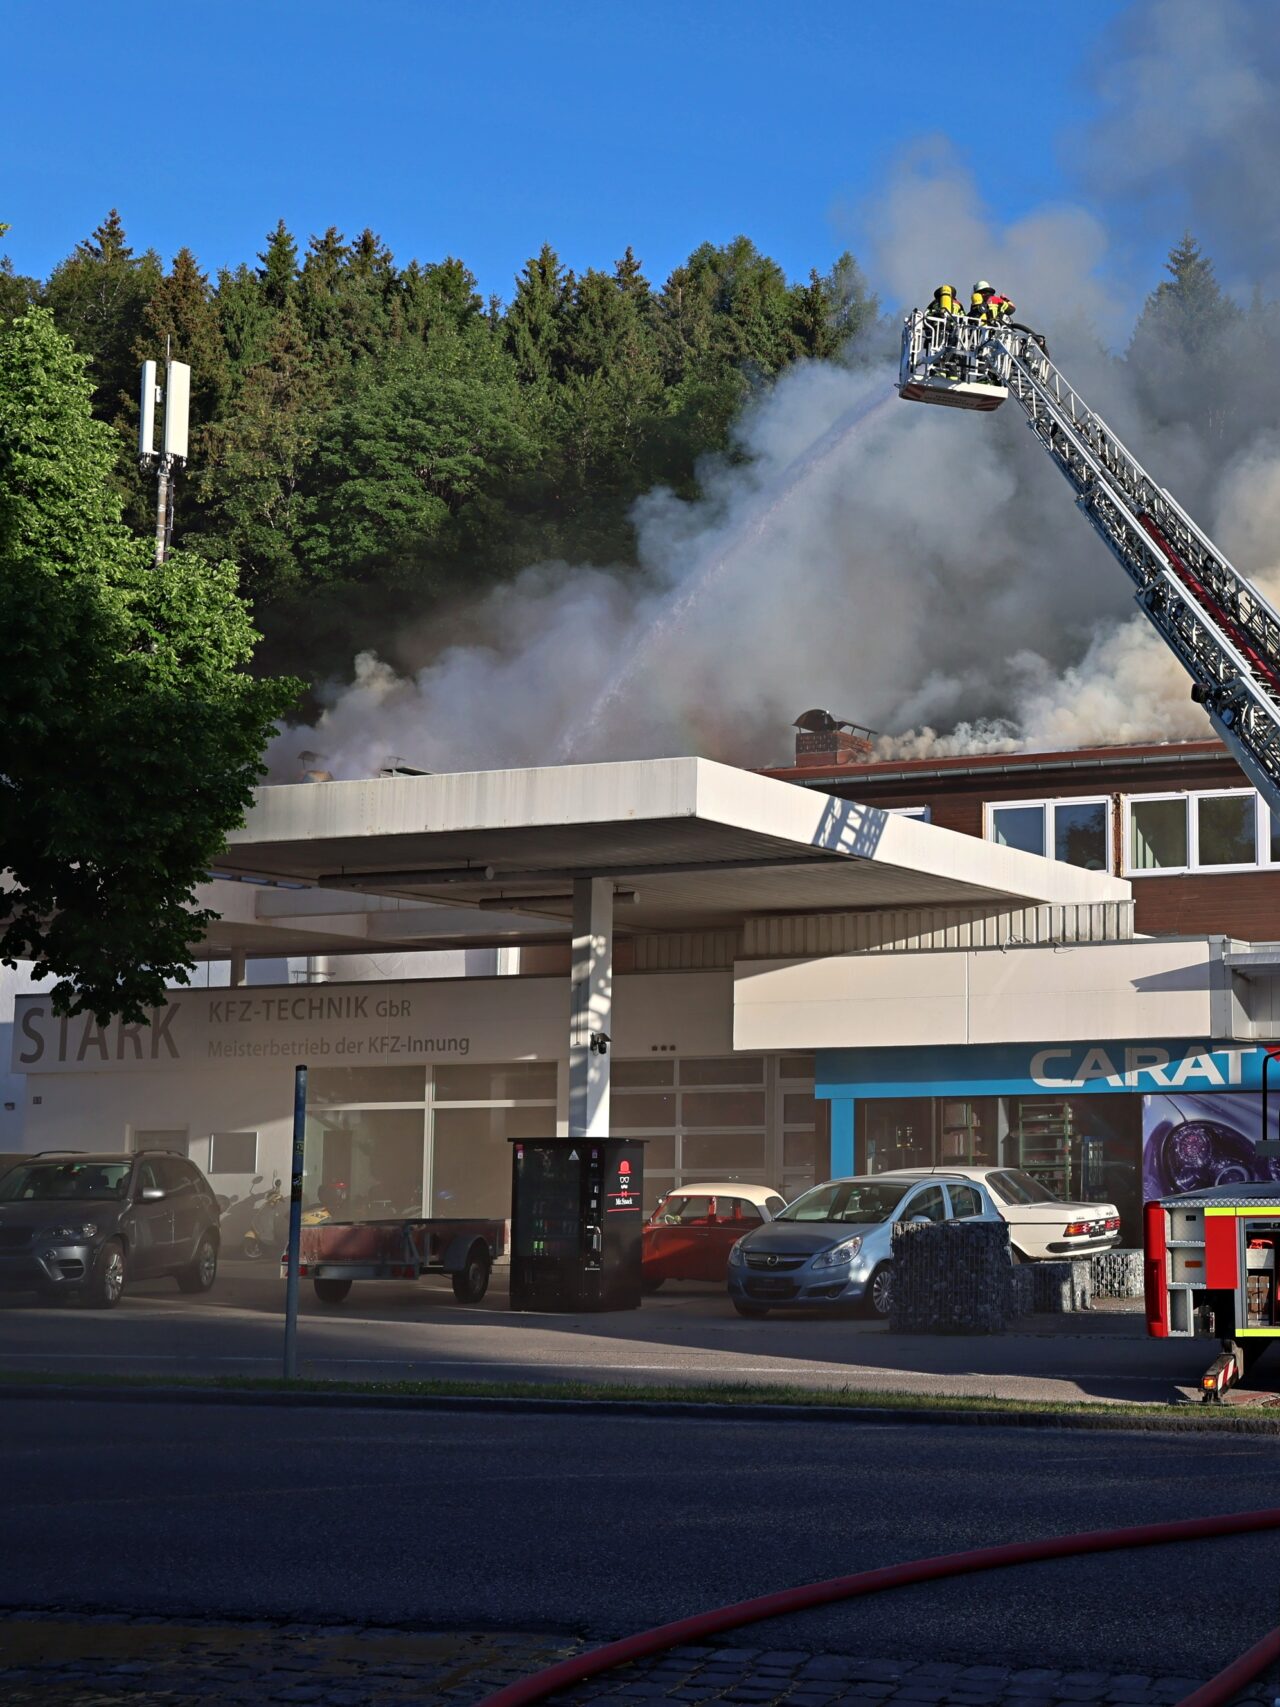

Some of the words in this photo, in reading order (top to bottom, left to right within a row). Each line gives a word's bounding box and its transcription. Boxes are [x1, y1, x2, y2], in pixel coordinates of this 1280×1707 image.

[209, 996, 368, 1022] KFZ-TECHNIK
[375, 1000, 411, 1017] GbR
[19, 1003, 181, 1063] STARK
[208, 1038, 330, 1057] Meisterbetrieb
[335, 1036, 364, 1054] der
[369, 1036, 470, 1055] KFZ-Innung
[1030, 1046, 1257, 1087] CARAT
